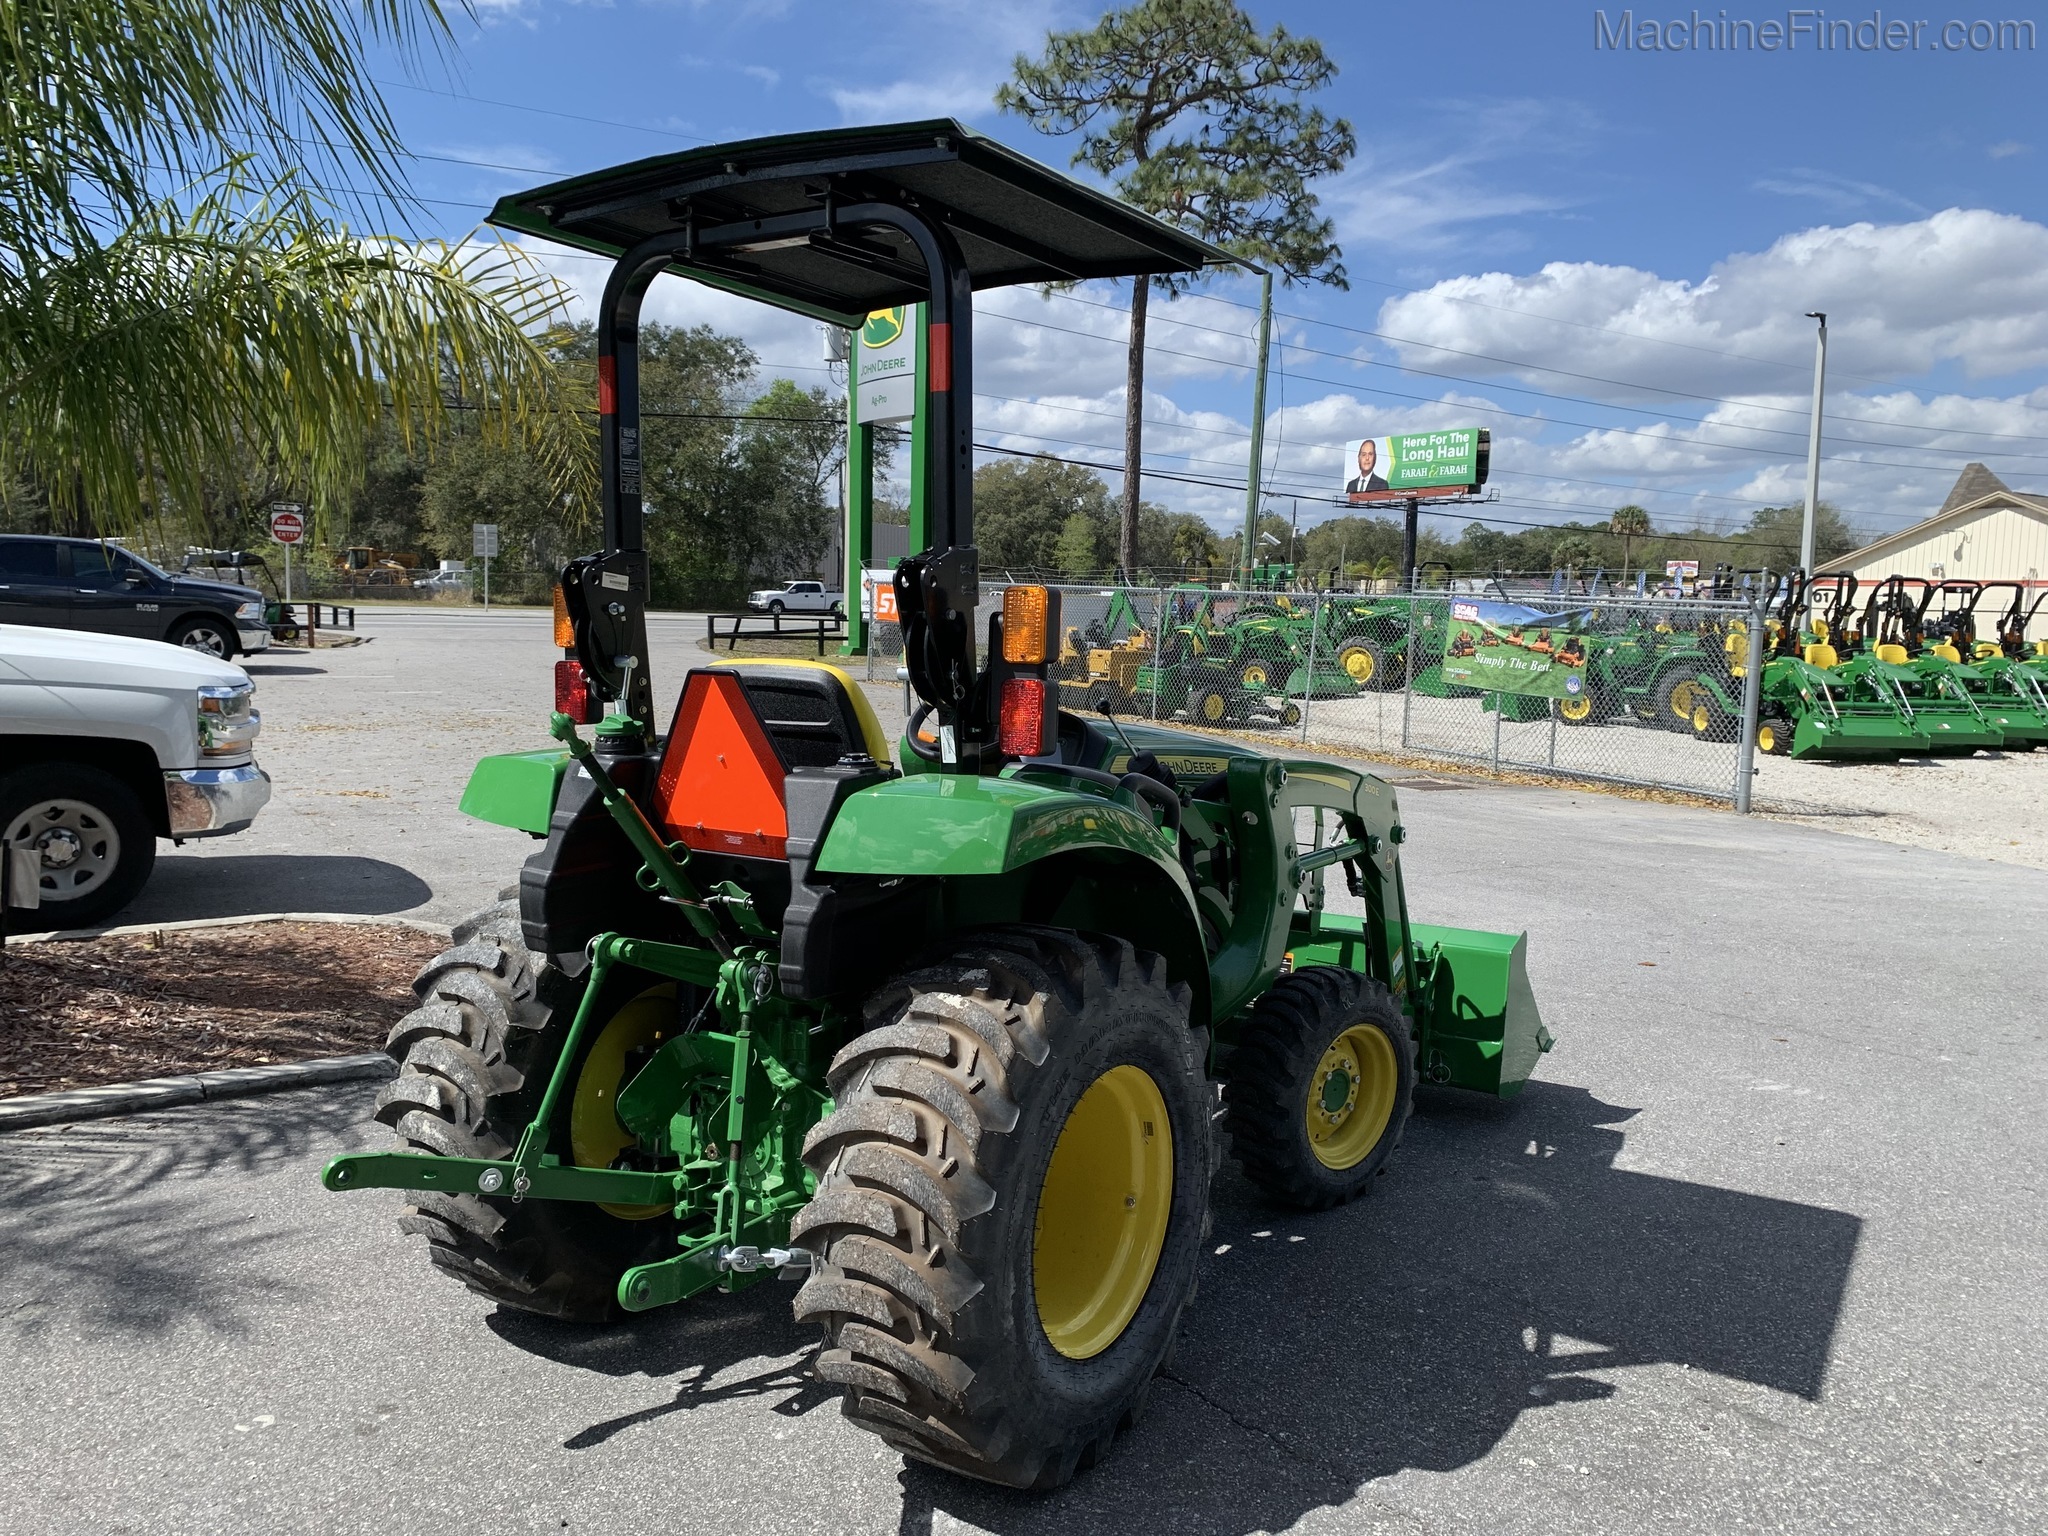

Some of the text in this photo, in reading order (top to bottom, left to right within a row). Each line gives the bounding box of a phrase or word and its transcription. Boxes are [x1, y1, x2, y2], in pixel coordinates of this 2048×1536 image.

[860, 357, 906, 377] JOHN DEERE
[1402, 432, 1470, 449] Here For The
[1402, 442, 1469, 463] Long Haul
[1401, 467, 1428, 478] FARAH
[1439, 464, 1468, 476] FARAH
[1454, 603, 1478, 617] SCAG
[1474, 652, 1553, 672] Simply The Best.
[1183, 759, 1218, 773] DEERE
